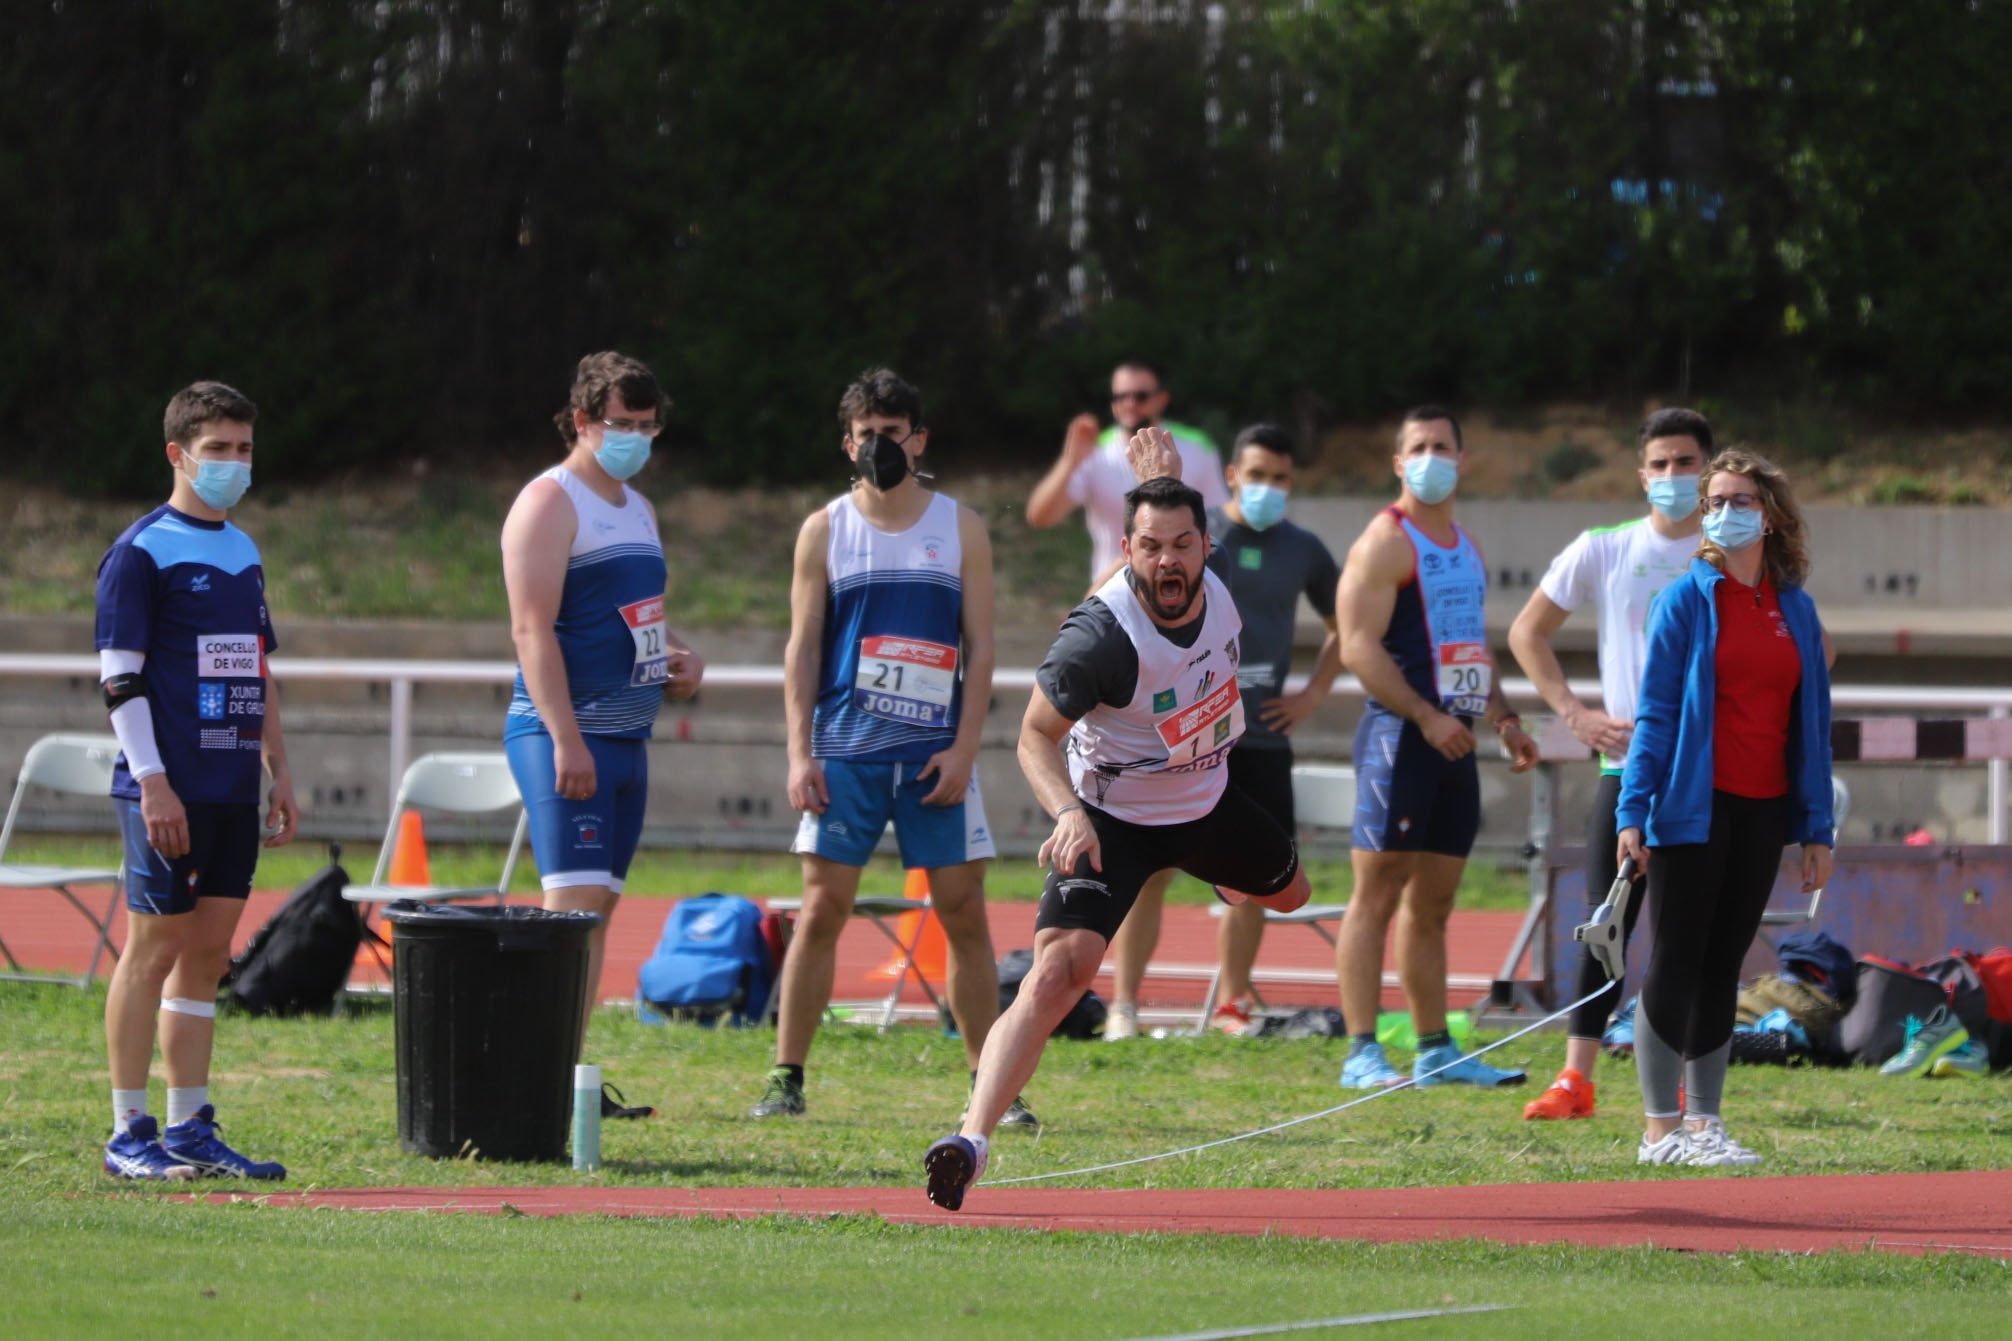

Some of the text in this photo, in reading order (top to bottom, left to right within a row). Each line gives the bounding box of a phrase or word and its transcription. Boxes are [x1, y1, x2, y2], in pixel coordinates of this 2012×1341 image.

[206, 642, 257, 654] CONCELLO
[642, 628, 660, 657] 22
[214, 658, 254, 669] DE VIGO
[872, 663, 904, 692] 21
[1452, 667, 1480, 692] 20
[230, 686, 261, 699] XUNTA
[228, 701, 245, 714] DE
[863, 694, 933, 721] Joma
[1190, 736, 1200, 758] 1
